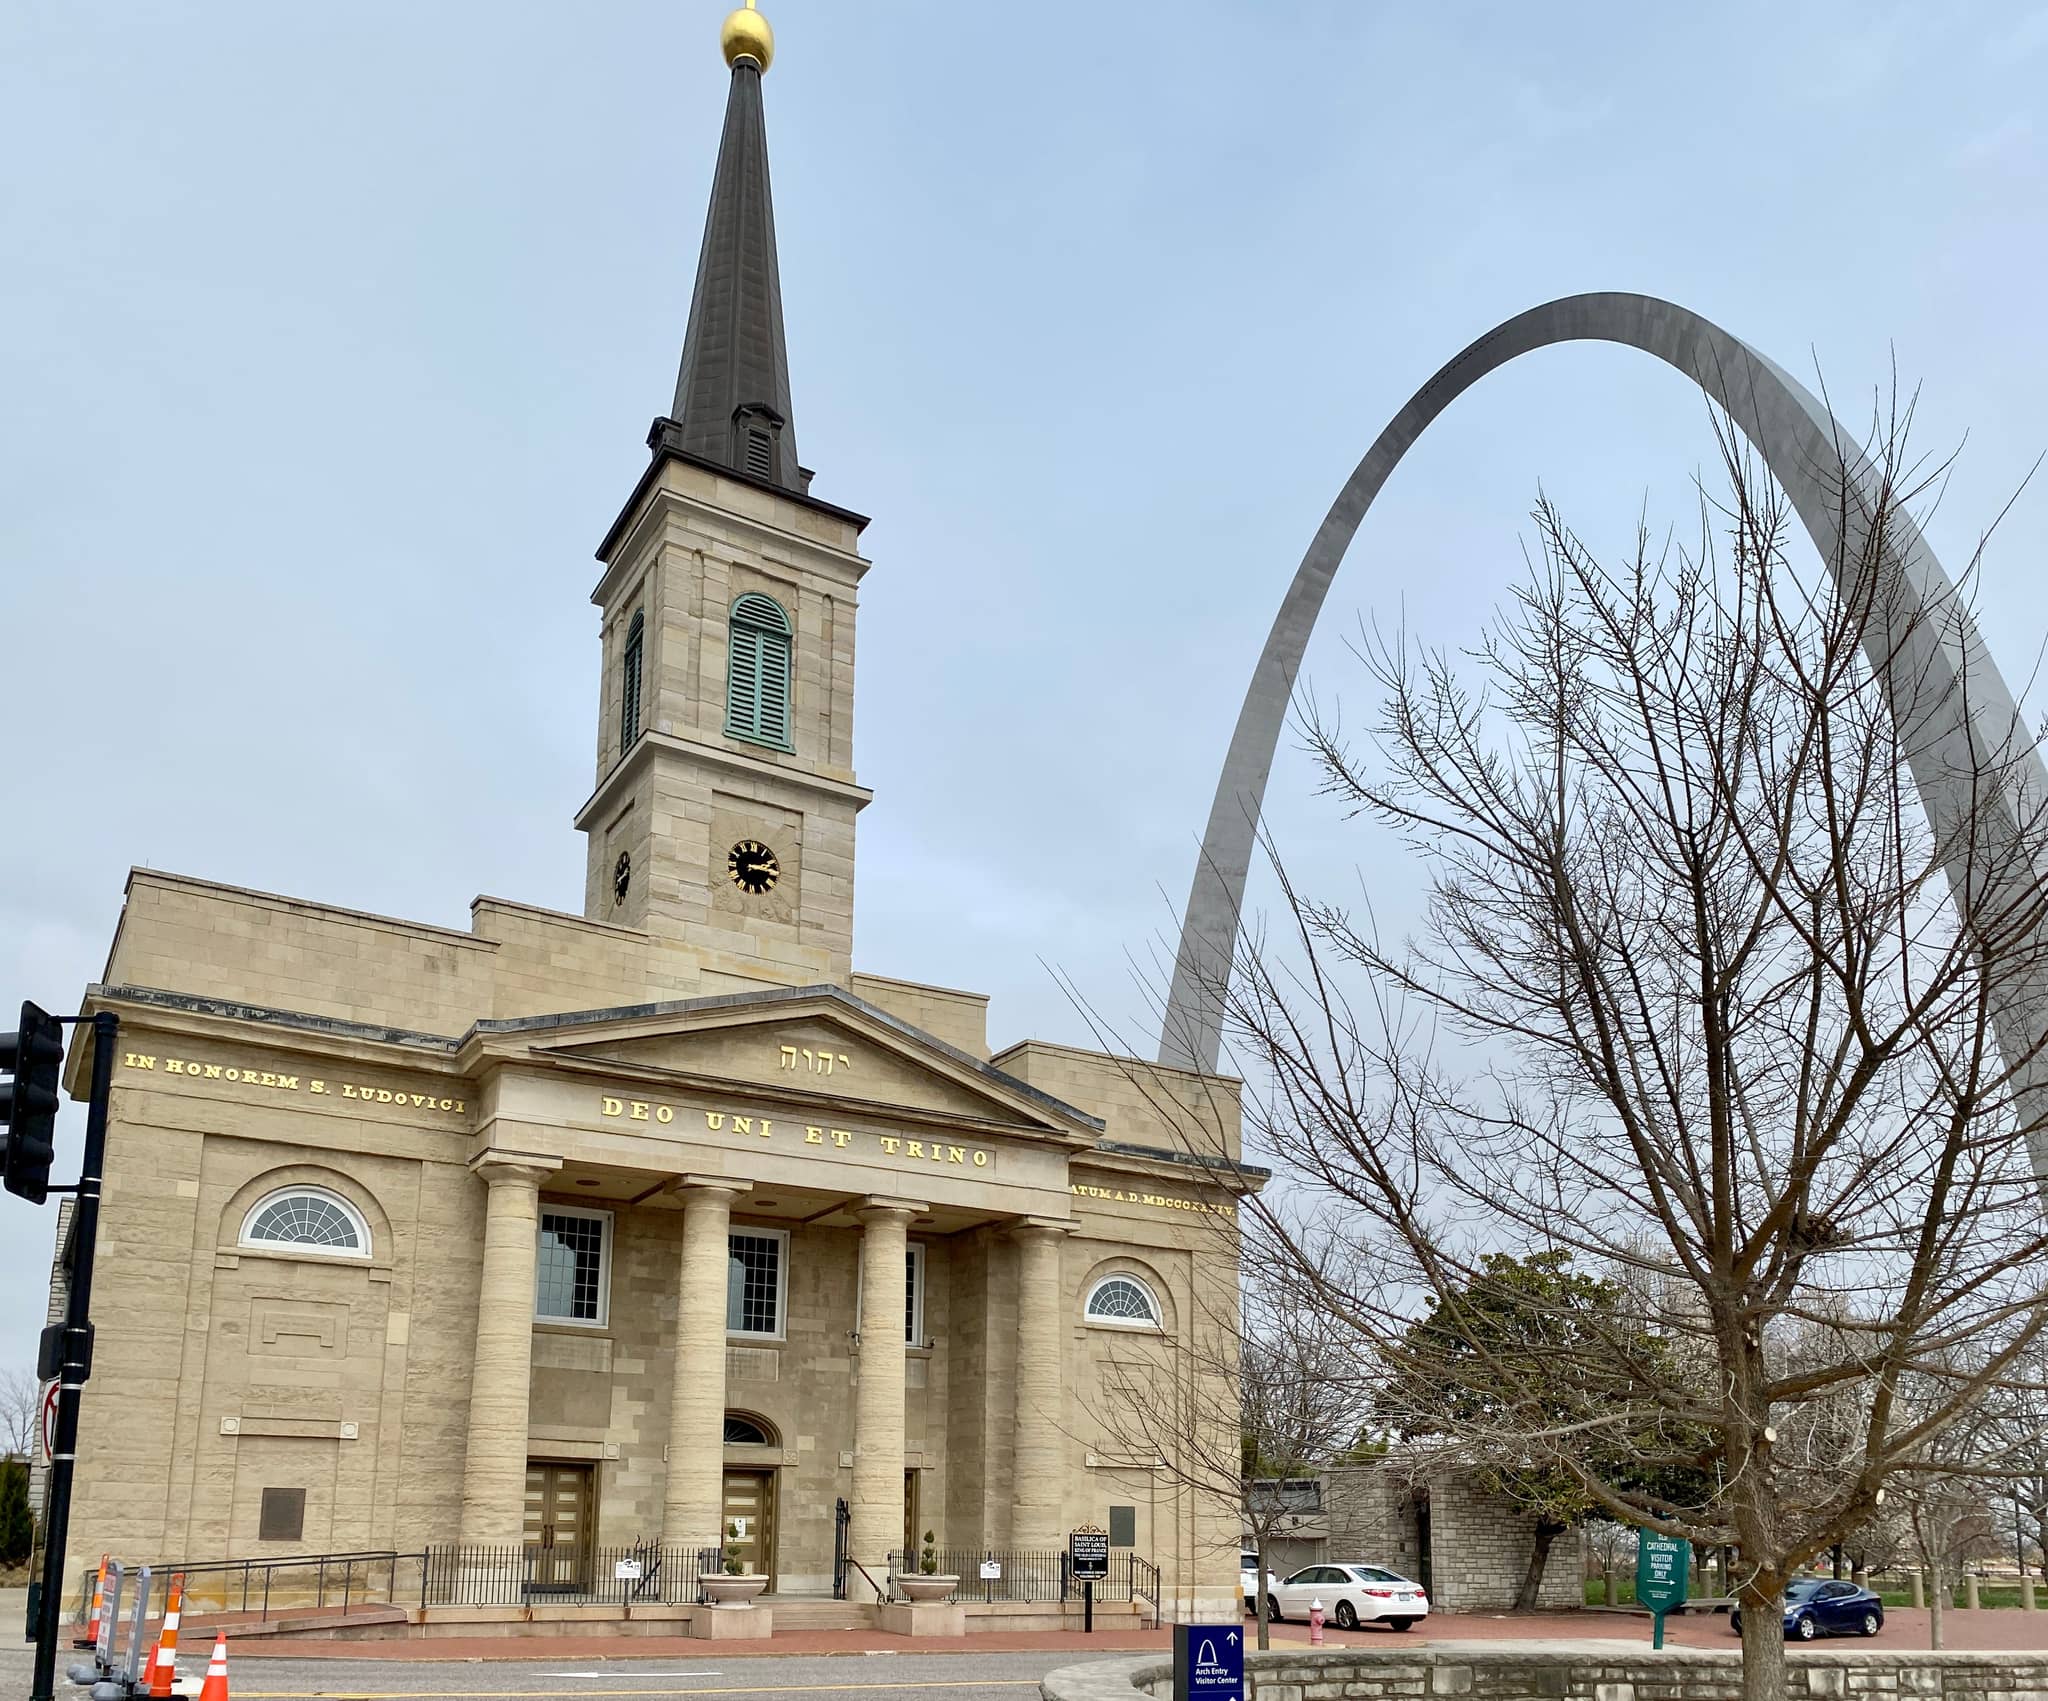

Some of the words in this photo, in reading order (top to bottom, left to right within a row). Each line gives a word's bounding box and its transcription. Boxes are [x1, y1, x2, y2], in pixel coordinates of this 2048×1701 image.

[780, 1045, 850, 1075] יהוה
[124, 1053, 156, 1070] IN
[165, 1058, 299, 1090] HONOREM
[310, 1080, 331, 1095] S.
[342, 1084, 465, 1113] LUDOVICI
[602, 1097, 673, 1123] DEO
[705, 1112, 772, 1138] UNI
[804, 1126, 852, 1147] ET
[880, 1136, 987, 1167] TRINO
[1646, 1541, 1679, 1552] CATHEDRAL
[1651, 1554, 1673, 1563] VISITOR
[1195, 1667, 1210, 1676] Arch
[1211, 1667, 1228, 1677] Entry
[1195, 1677, 1216, 1685] Visitor
